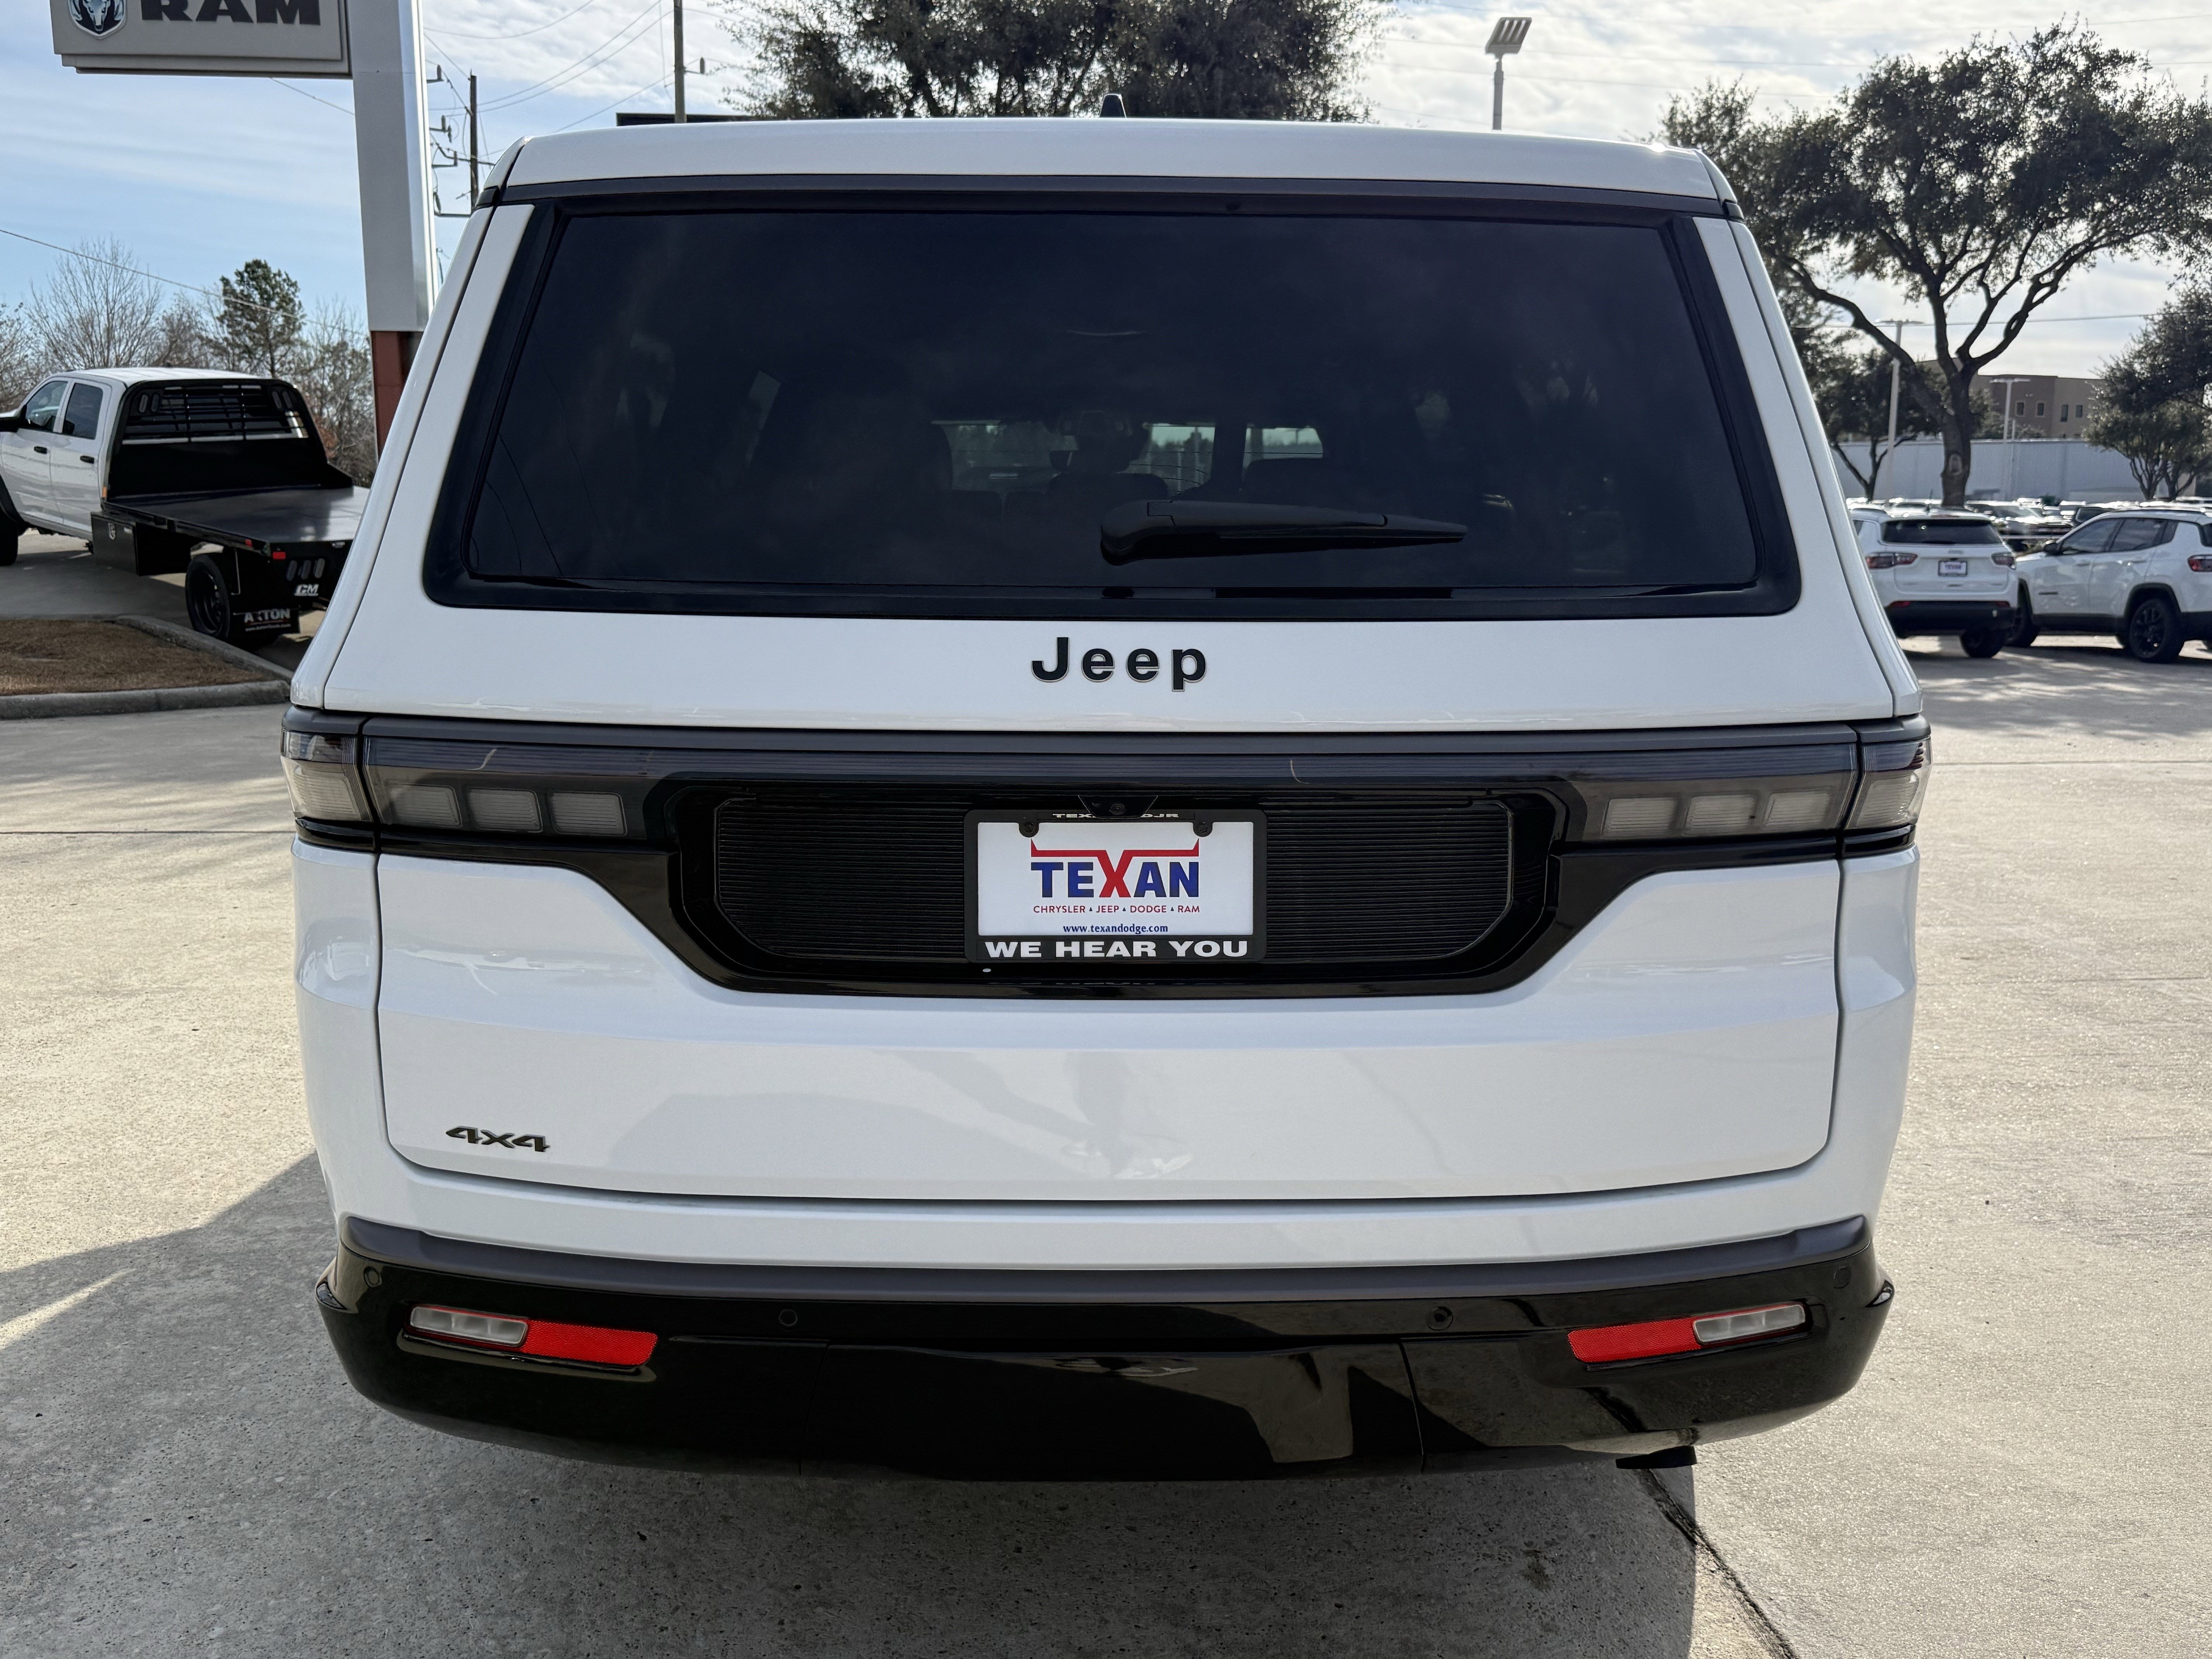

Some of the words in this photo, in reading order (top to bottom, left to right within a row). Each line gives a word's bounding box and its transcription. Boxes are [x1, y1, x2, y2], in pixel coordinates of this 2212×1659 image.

[141, 0, 321, 25] RAM
[1031, 637, 1207, 692] Jeep
[1031, 847, 1199, 898] TEXAN
[1034, 905, 1085, 913] CHRYSLER
[1063, 924, 1168, 934] www.texandodge.com
[985, 941, 1042, 958] WE
[1056, 941, 1156, 958] HEAR
[1168, 941, 1249, 957] YOU
